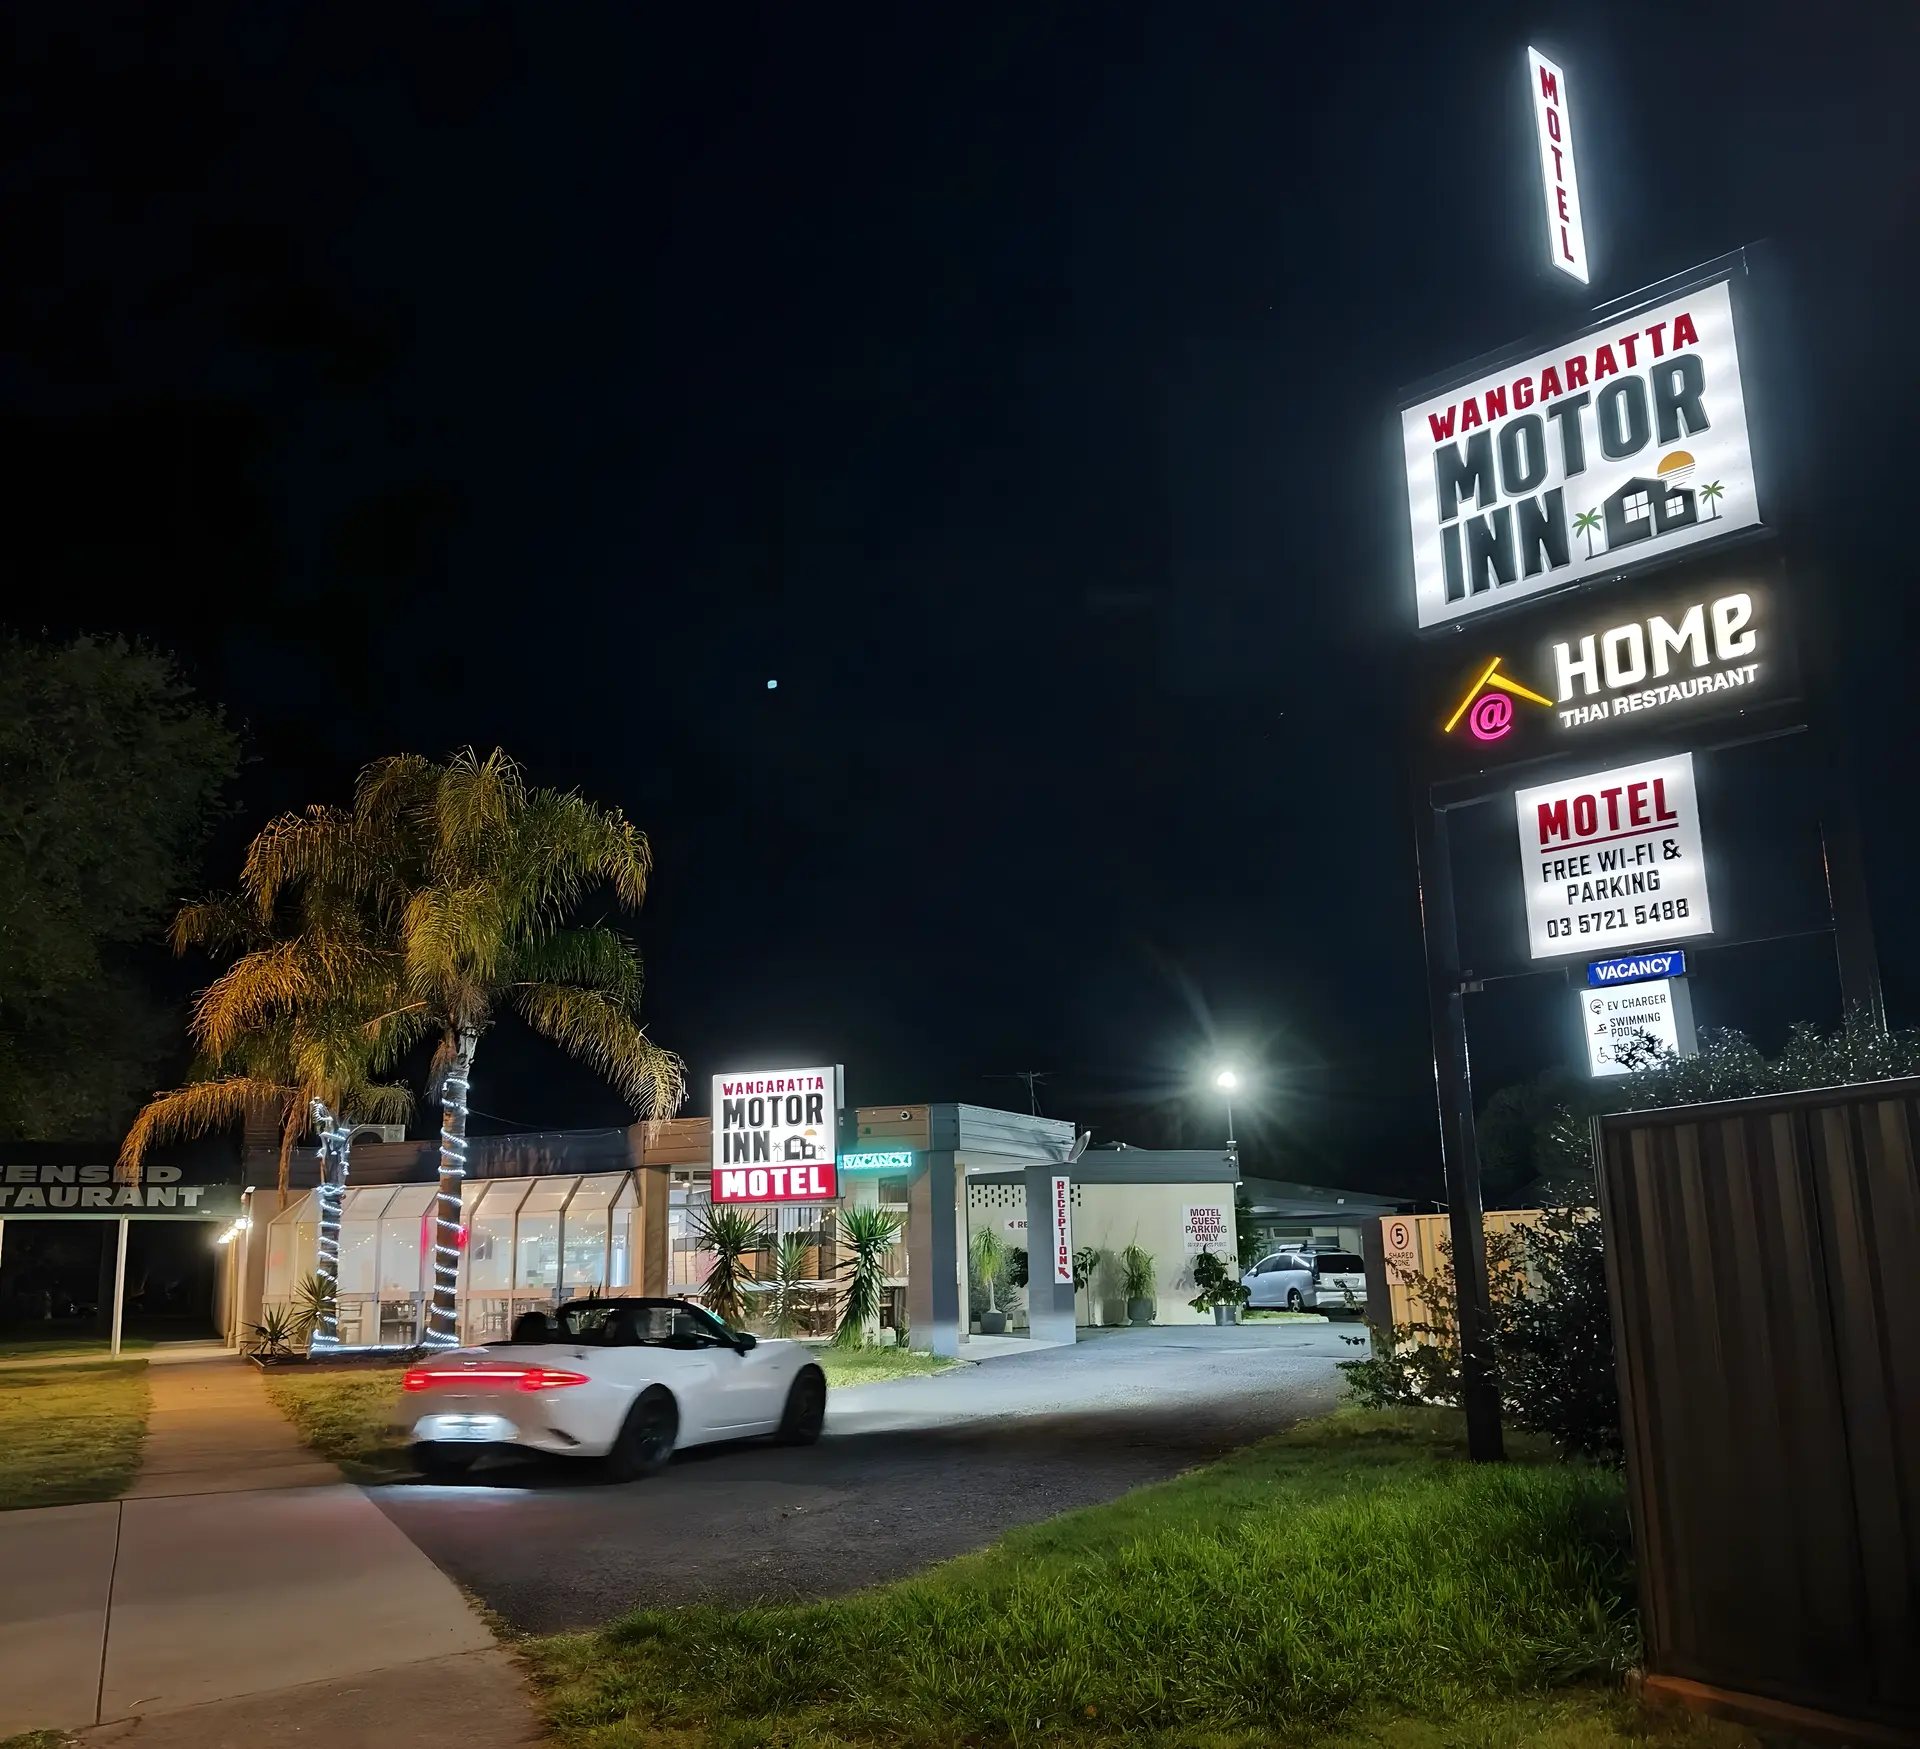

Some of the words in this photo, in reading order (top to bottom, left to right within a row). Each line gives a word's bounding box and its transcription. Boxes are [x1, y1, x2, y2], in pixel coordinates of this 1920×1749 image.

[1539, 65, 1574, 263] MOTEL
[1428, 313, 1699, 442] WANGARATTA
[1433, 354, 1711, 524] MOTOR
[1440, 486, 1571, 605] INN
[1559, 704, 1609, 728] THAI
[1612, 664, 1758, 717] RESTAURANT
[1537, 778, 1678, 845] MOTEL
[1542, 853, 1592, 883] FREE
[1597, 842, 1655, 873] WI-FI
[1663, 839, 1683, 861] &
[1567, 869, 1661, 905] PARKING
[1547, 915, 1572, 938] 03
[1579, 908, 1629, 933] 5721
[1634, 898, 1690, 925] 5488
[1596, 957, 1672, 981] VACANCY
[1607, 1001, 1619, 1011] EV
[1622, 994, 1667, 1009] CHARGER
[1610, 1012, 1661, 1028] SWIMMING
[722, 1076, 824, 1096] WANGARATTA
[722, 1093, 824, 1131] MOTOR
[722, 1130, 771, 1165] INN
[844, 1152, 911, 1168] VACANCY
[721, 1166, 826, 1198] MOTEL
[1057, 1181, 1067, 1264] RECEPTION
[1185, 1225, 1227, 1233] PARKING
[1190, 1208, 1221, 1216] MOTEL
[1191, 1217, 1221, 1225] GUEST
[1195, 1233, 1219, 1241] ONLY
[1396, 1228, 1404, 1244] 5
